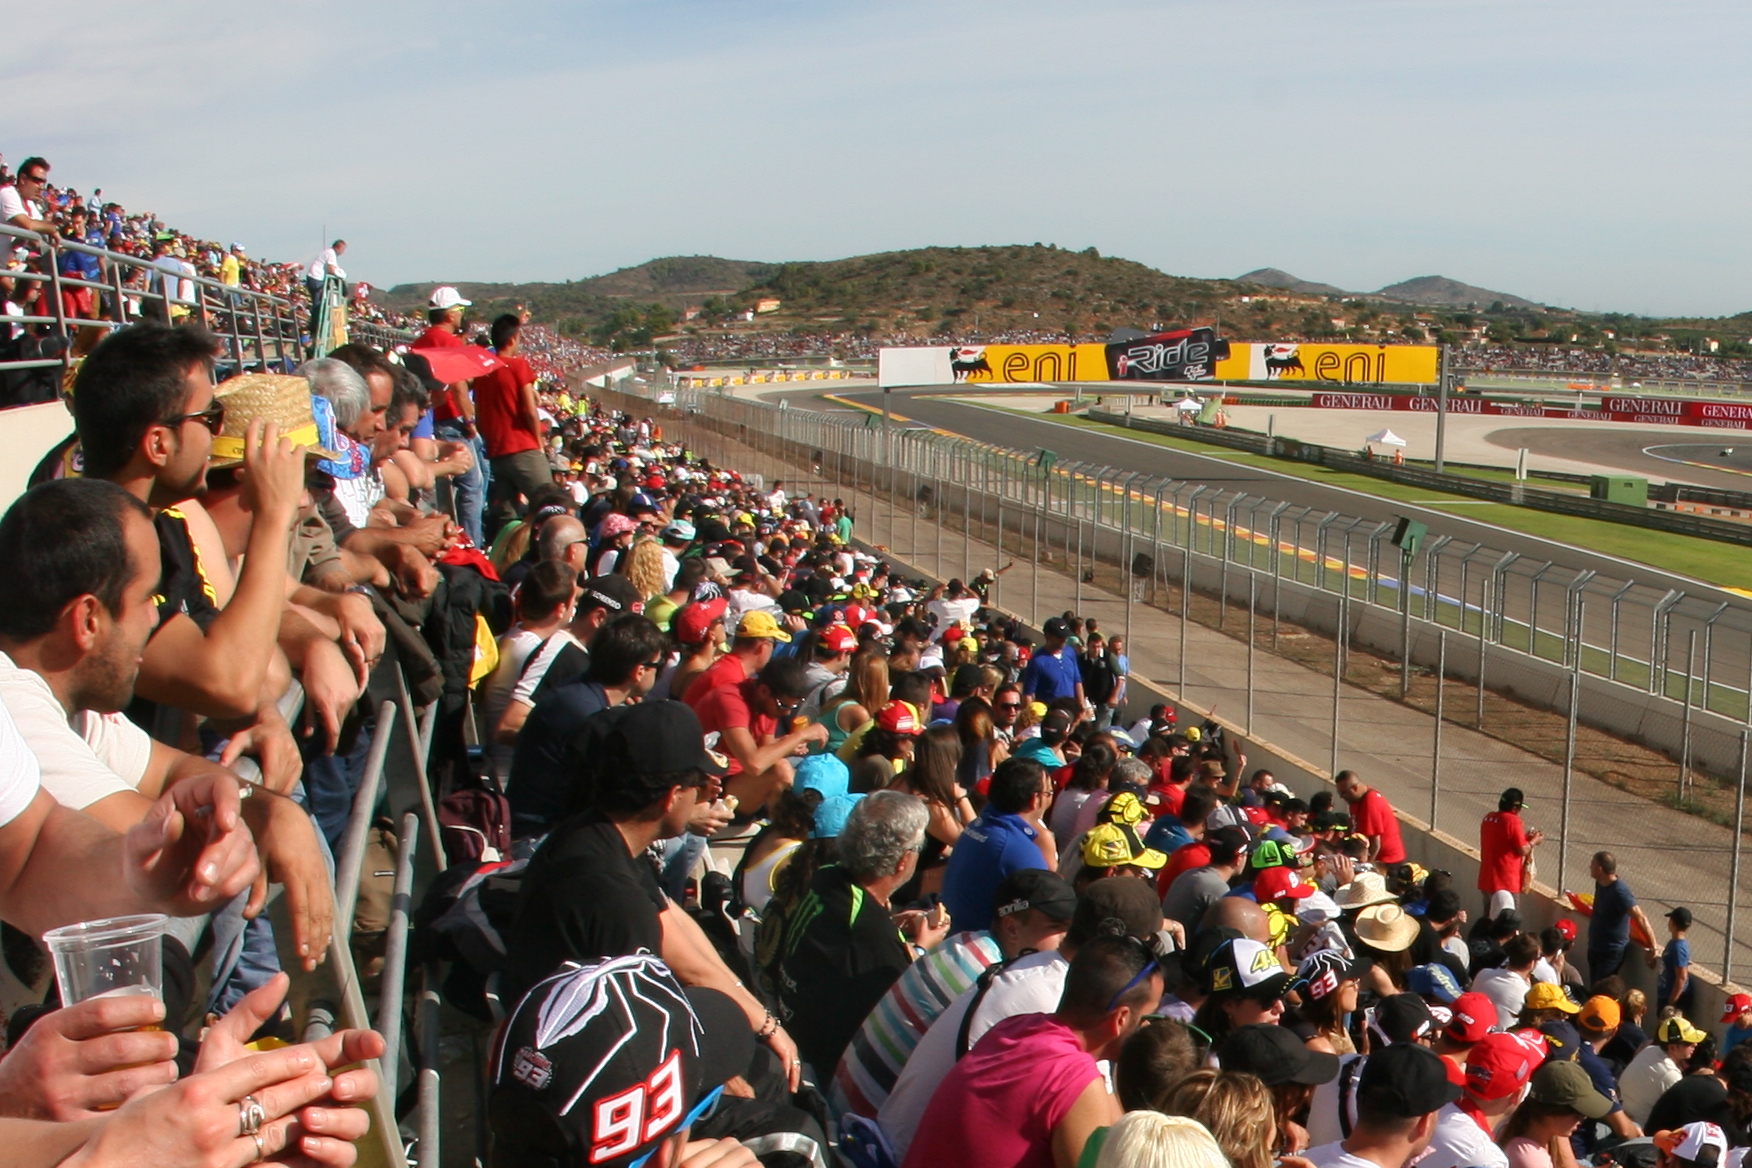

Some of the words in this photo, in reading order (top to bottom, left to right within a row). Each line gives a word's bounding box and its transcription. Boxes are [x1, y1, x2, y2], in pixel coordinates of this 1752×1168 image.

[1003, 344, 1077, 382] eni
[1315, 345, 1387, 386] eni
[1320, 393, 1393, 410] GENERALI
[1610, 398, 1682, 415] GENERALI
[1567, 411, 1612, 421] GENERALI
[1634, 414, 1680, 424] GENERALI
[1701, 418, 1746, 430] GENERALI
[592, 590, 621, 609] LORENZO
[1309, 969, 1338, 1000] 93
[513, 1059, 549, 1089] 93
[591, 1048, 683, 1164] 93
